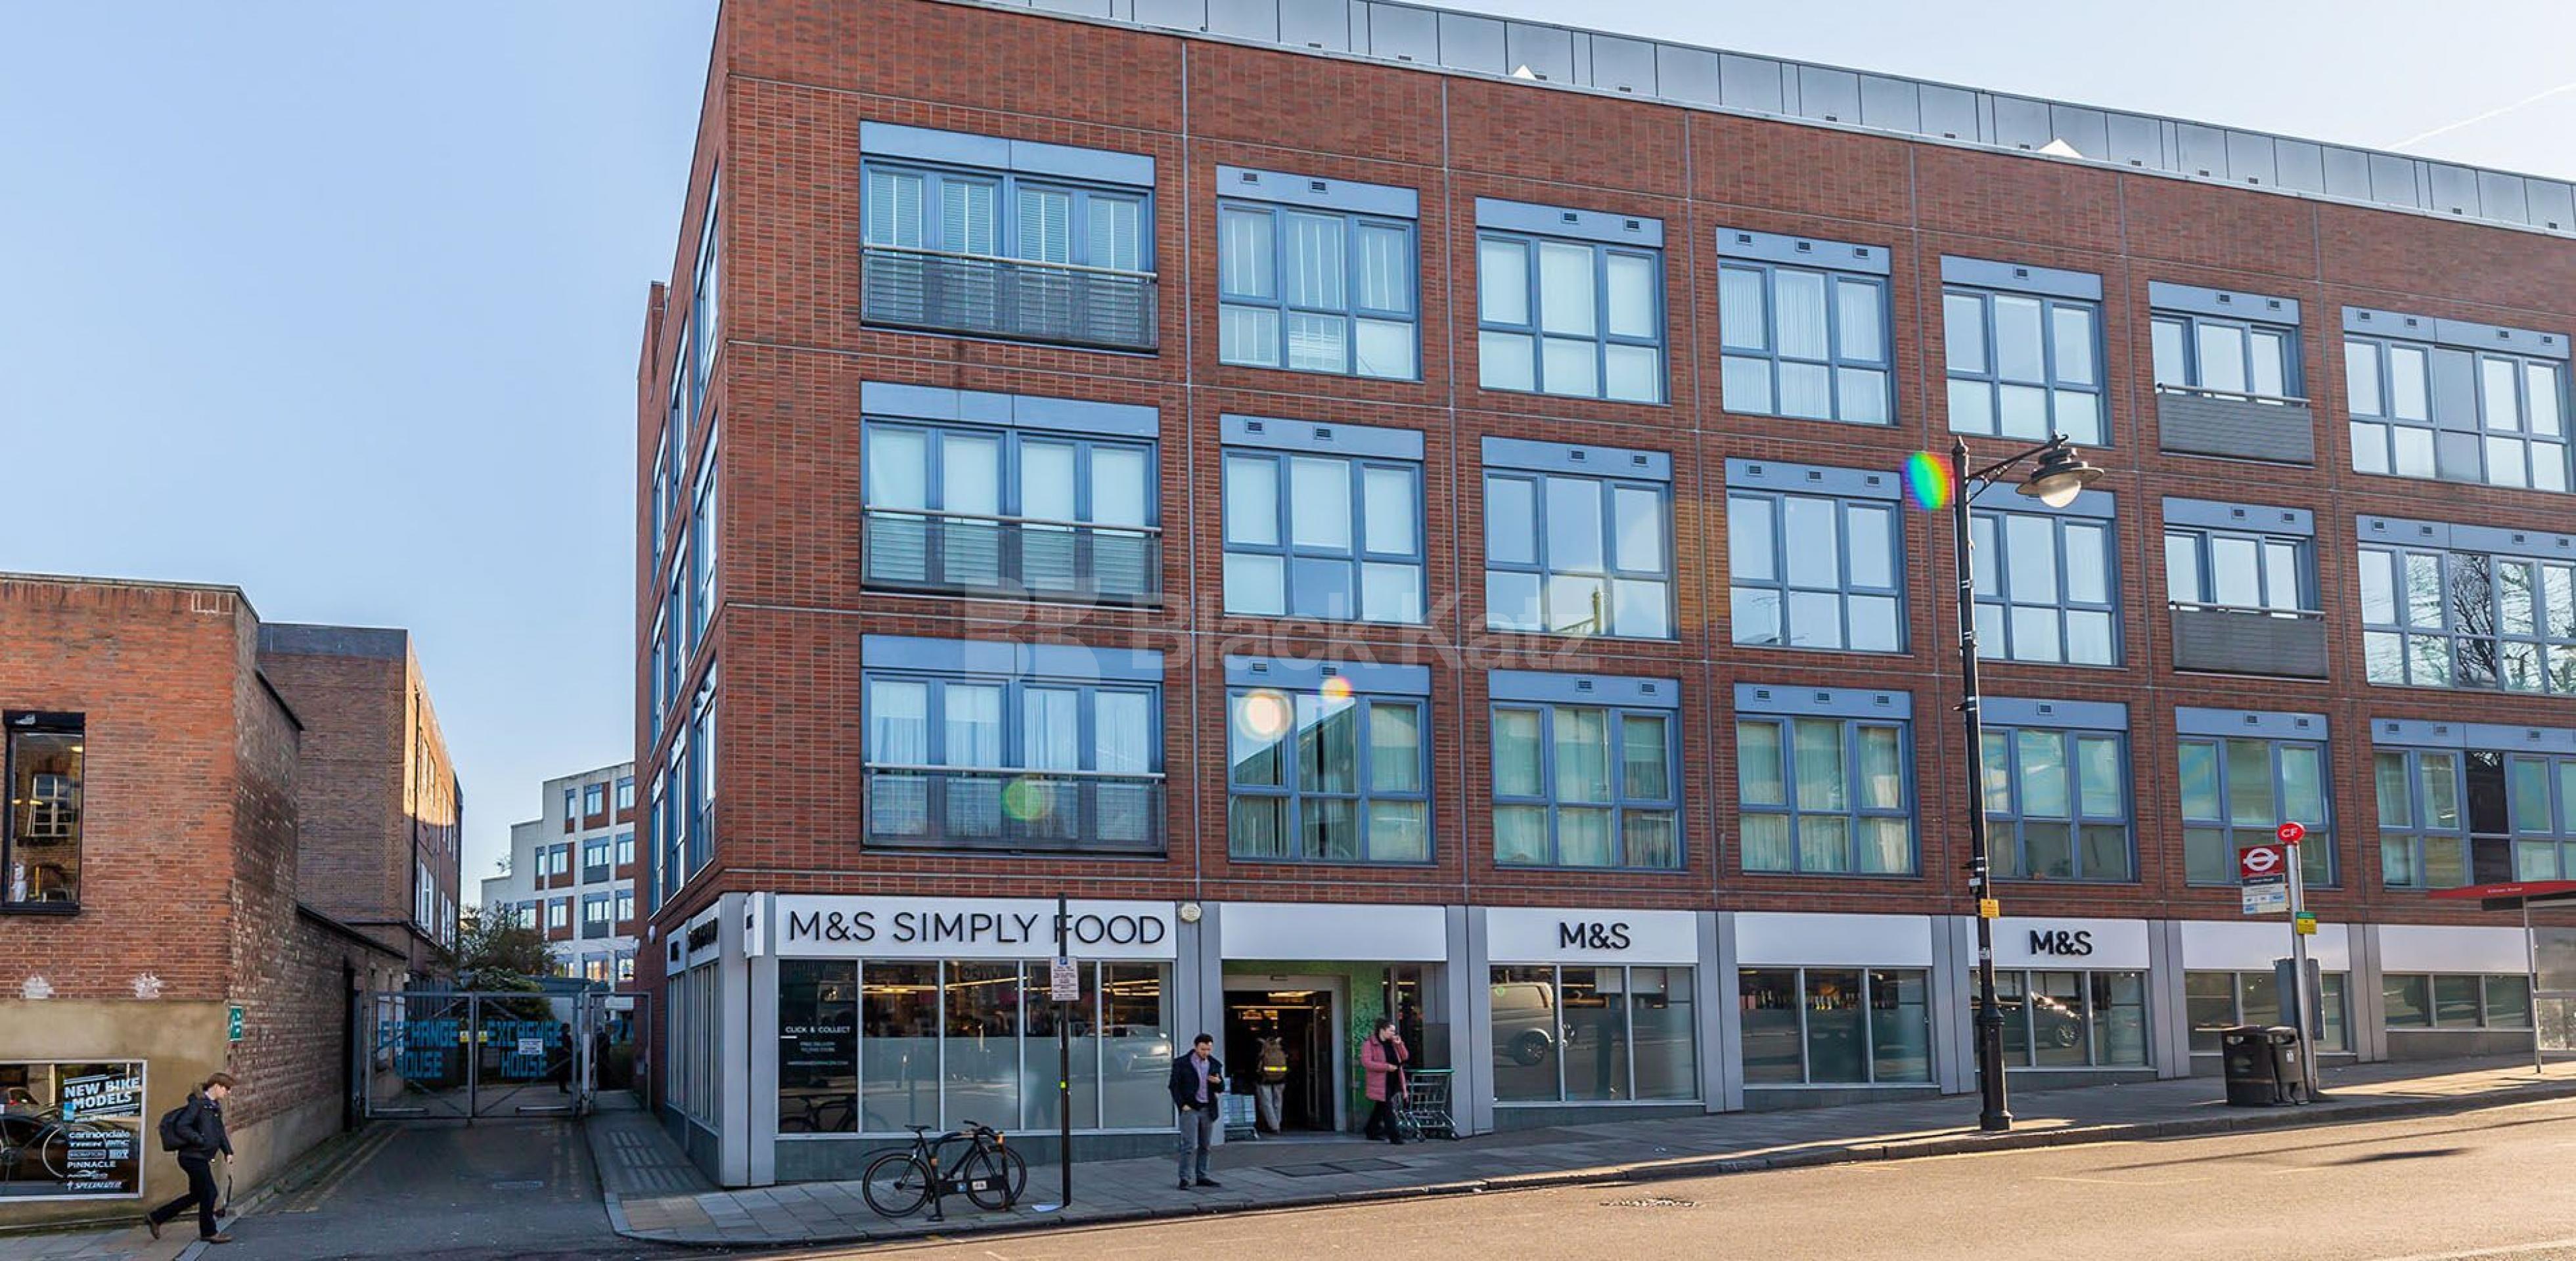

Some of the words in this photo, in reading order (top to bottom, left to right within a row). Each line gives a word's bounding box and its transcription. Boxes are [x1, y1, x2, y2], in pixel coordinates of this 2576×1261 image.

[2282, 828, 2299, 838] CF
[790, 910, 876, 942] M&S
[893, 911, 1039, 943] SIMPLY
[1054, 914, 1165, 944] FOOD
[1560, 922, 1631, 950] M&S
[2029, 930, 2093, 956] M&S
[64, 1082, 101, 1098] NEW
[105, 1077, 140, 1092] BIKE
[72, 1092, 132, 1110] MODELS
